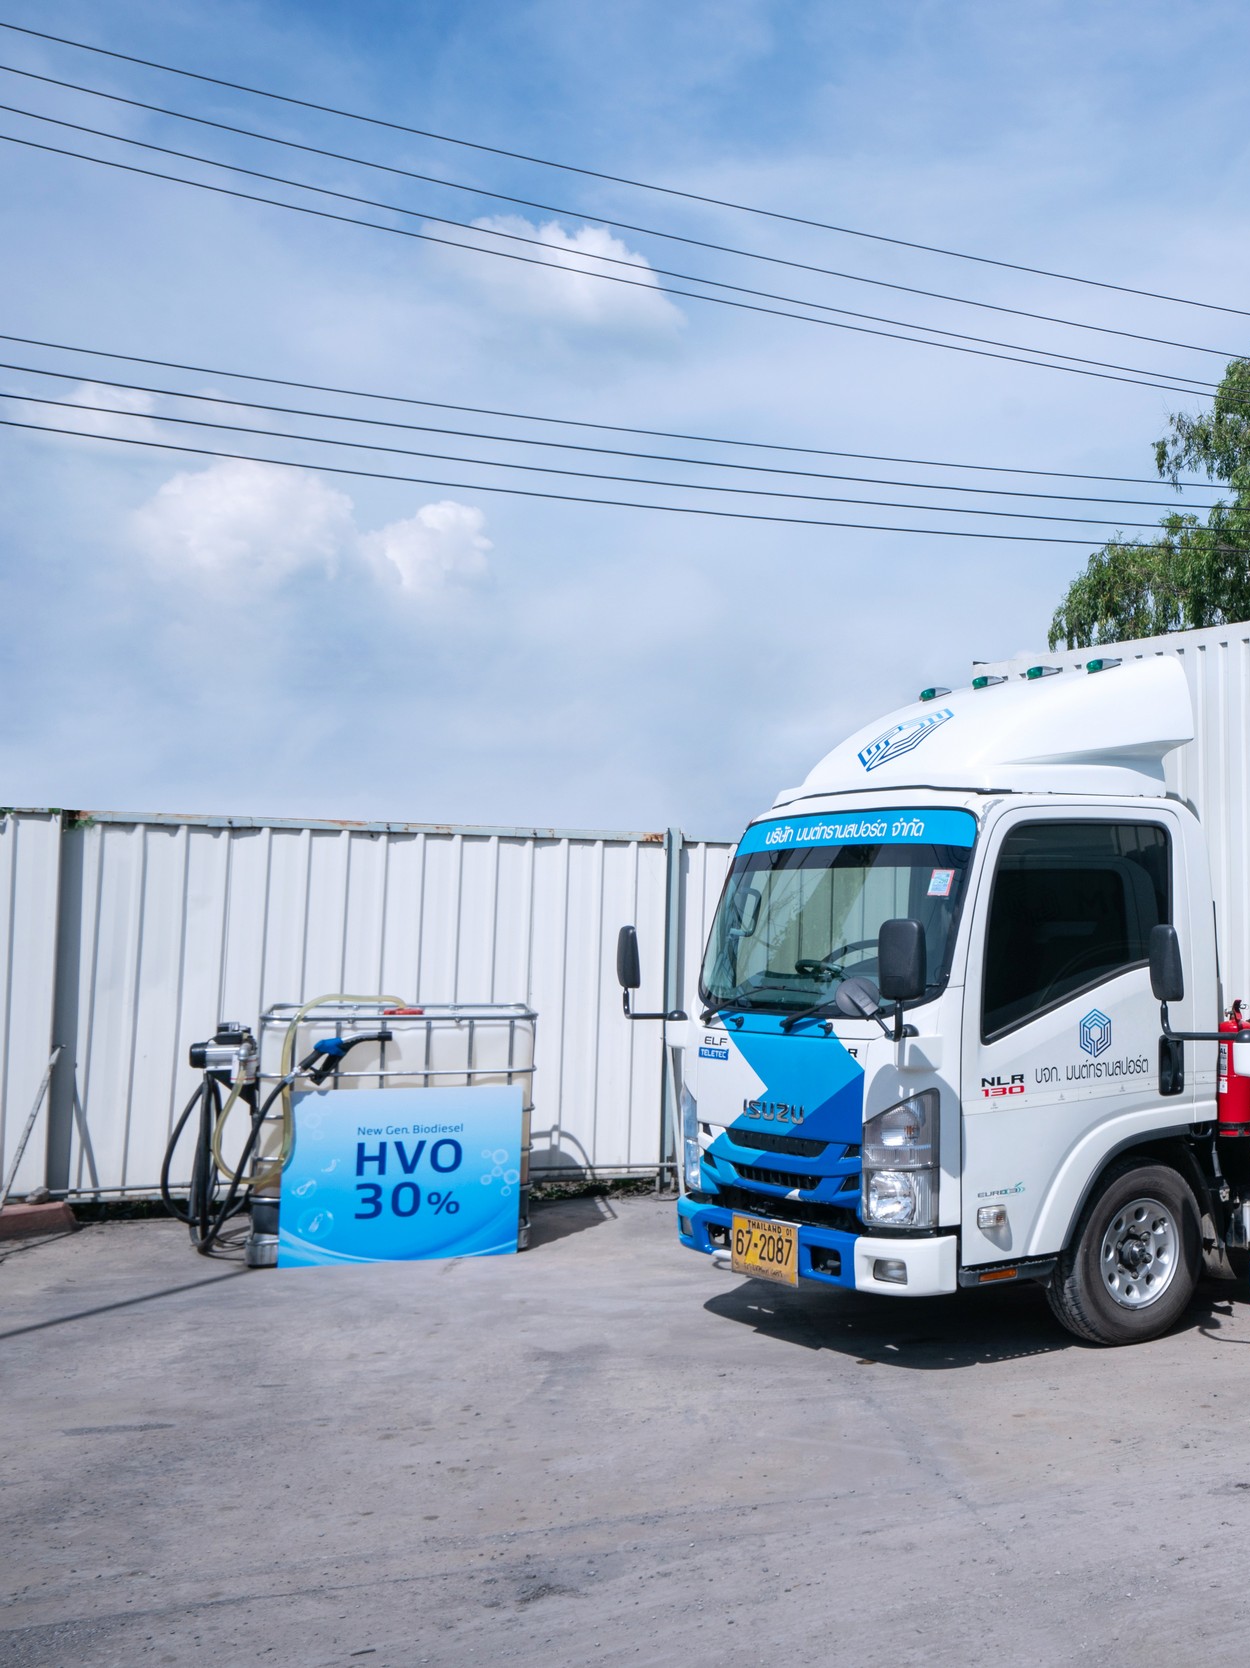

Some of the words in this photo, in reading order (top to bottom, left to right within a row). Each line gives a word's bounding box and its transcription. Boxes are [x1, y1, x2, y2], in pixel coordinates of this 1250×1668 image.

[766, 825, 794, 845] บริษัท
[796, 819, 887, 842] มนต์ทรานสปอร์ต
[891, 817, 925, 837] จำกัด
[704, 1036, 728, 1046] ELF
[700, 1048, 728, 1060] TELETEC
[1035, 1066, 1061, 1084] บจก.
[1065, 1055, 1149, 1081] มนต์ทรานสปอร์ต
[981, 1073, 1025, 1088] NLR
[981, 1085, 1025, 1098] 130
[743, 1098, 805, 1125] ISUZU
[357, 1126, 383, 1136] New
[412, 1123, 464, 1134] Biodiesel
[356, 1138, 463, 1177] HVO
[354, 1181, 460, 1220] 30%
[747, 1219, 782, 1234] THAILAND
[735, 1228, 793, 1267] 67-2087
